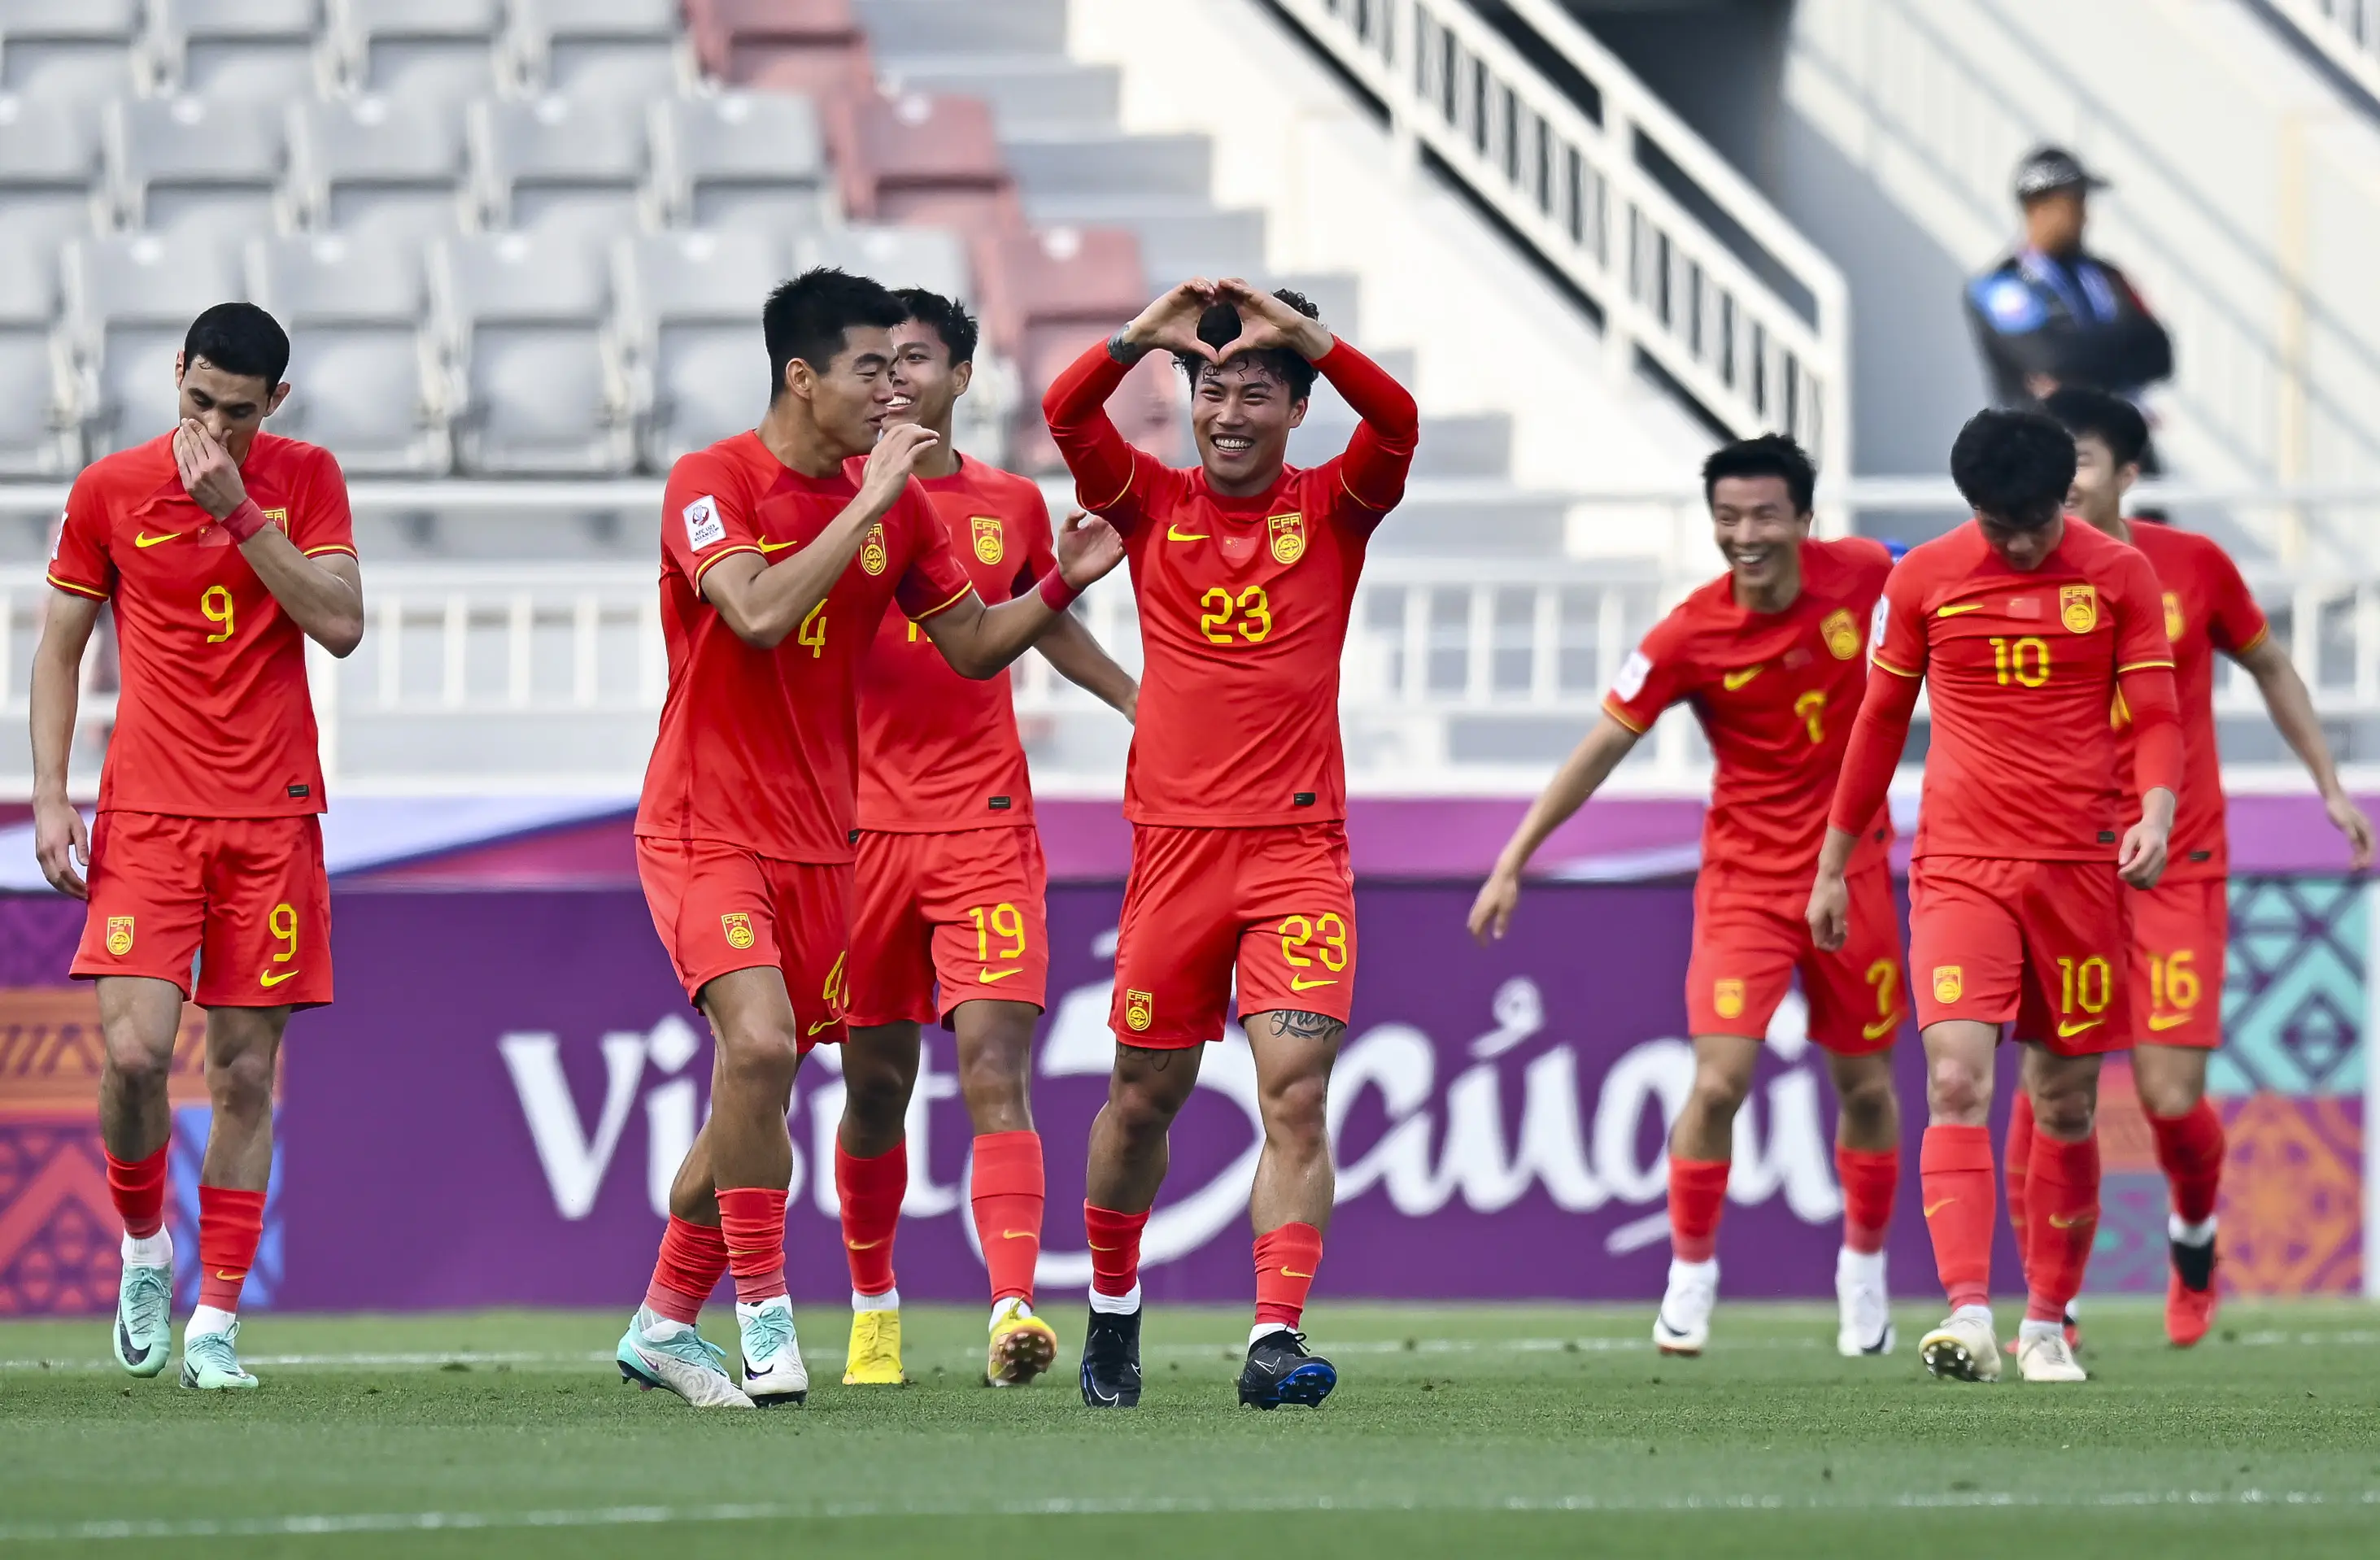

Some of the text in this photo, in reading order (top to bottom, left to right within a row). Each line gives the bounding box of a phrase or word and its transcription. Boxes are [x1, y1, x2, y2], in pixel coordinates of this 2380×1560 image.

[974, 521, 1000, 532] CFA
[1271, 516, 1300, 529] CFA
[201, 586, 234, 643] 9
[798, 599, 828, 658] 4
[1201, 586, 1271, 643] 23
[1990, 637, 2050, 687] 10
[110, 919, 132, 928] CFA
[269, 904, 298, 962] 9
[724, 915, 748, 925] CFA
[969, 903, 1026, 961] 19
[1278, 913, 1347, 972] 23
[823, 953, 846, 1009] 4
[1128, 991, 1149, 1003] CFA
[2057, 957, 2111, 1014] 10
[2147, 948, 2202, 1010] 16
